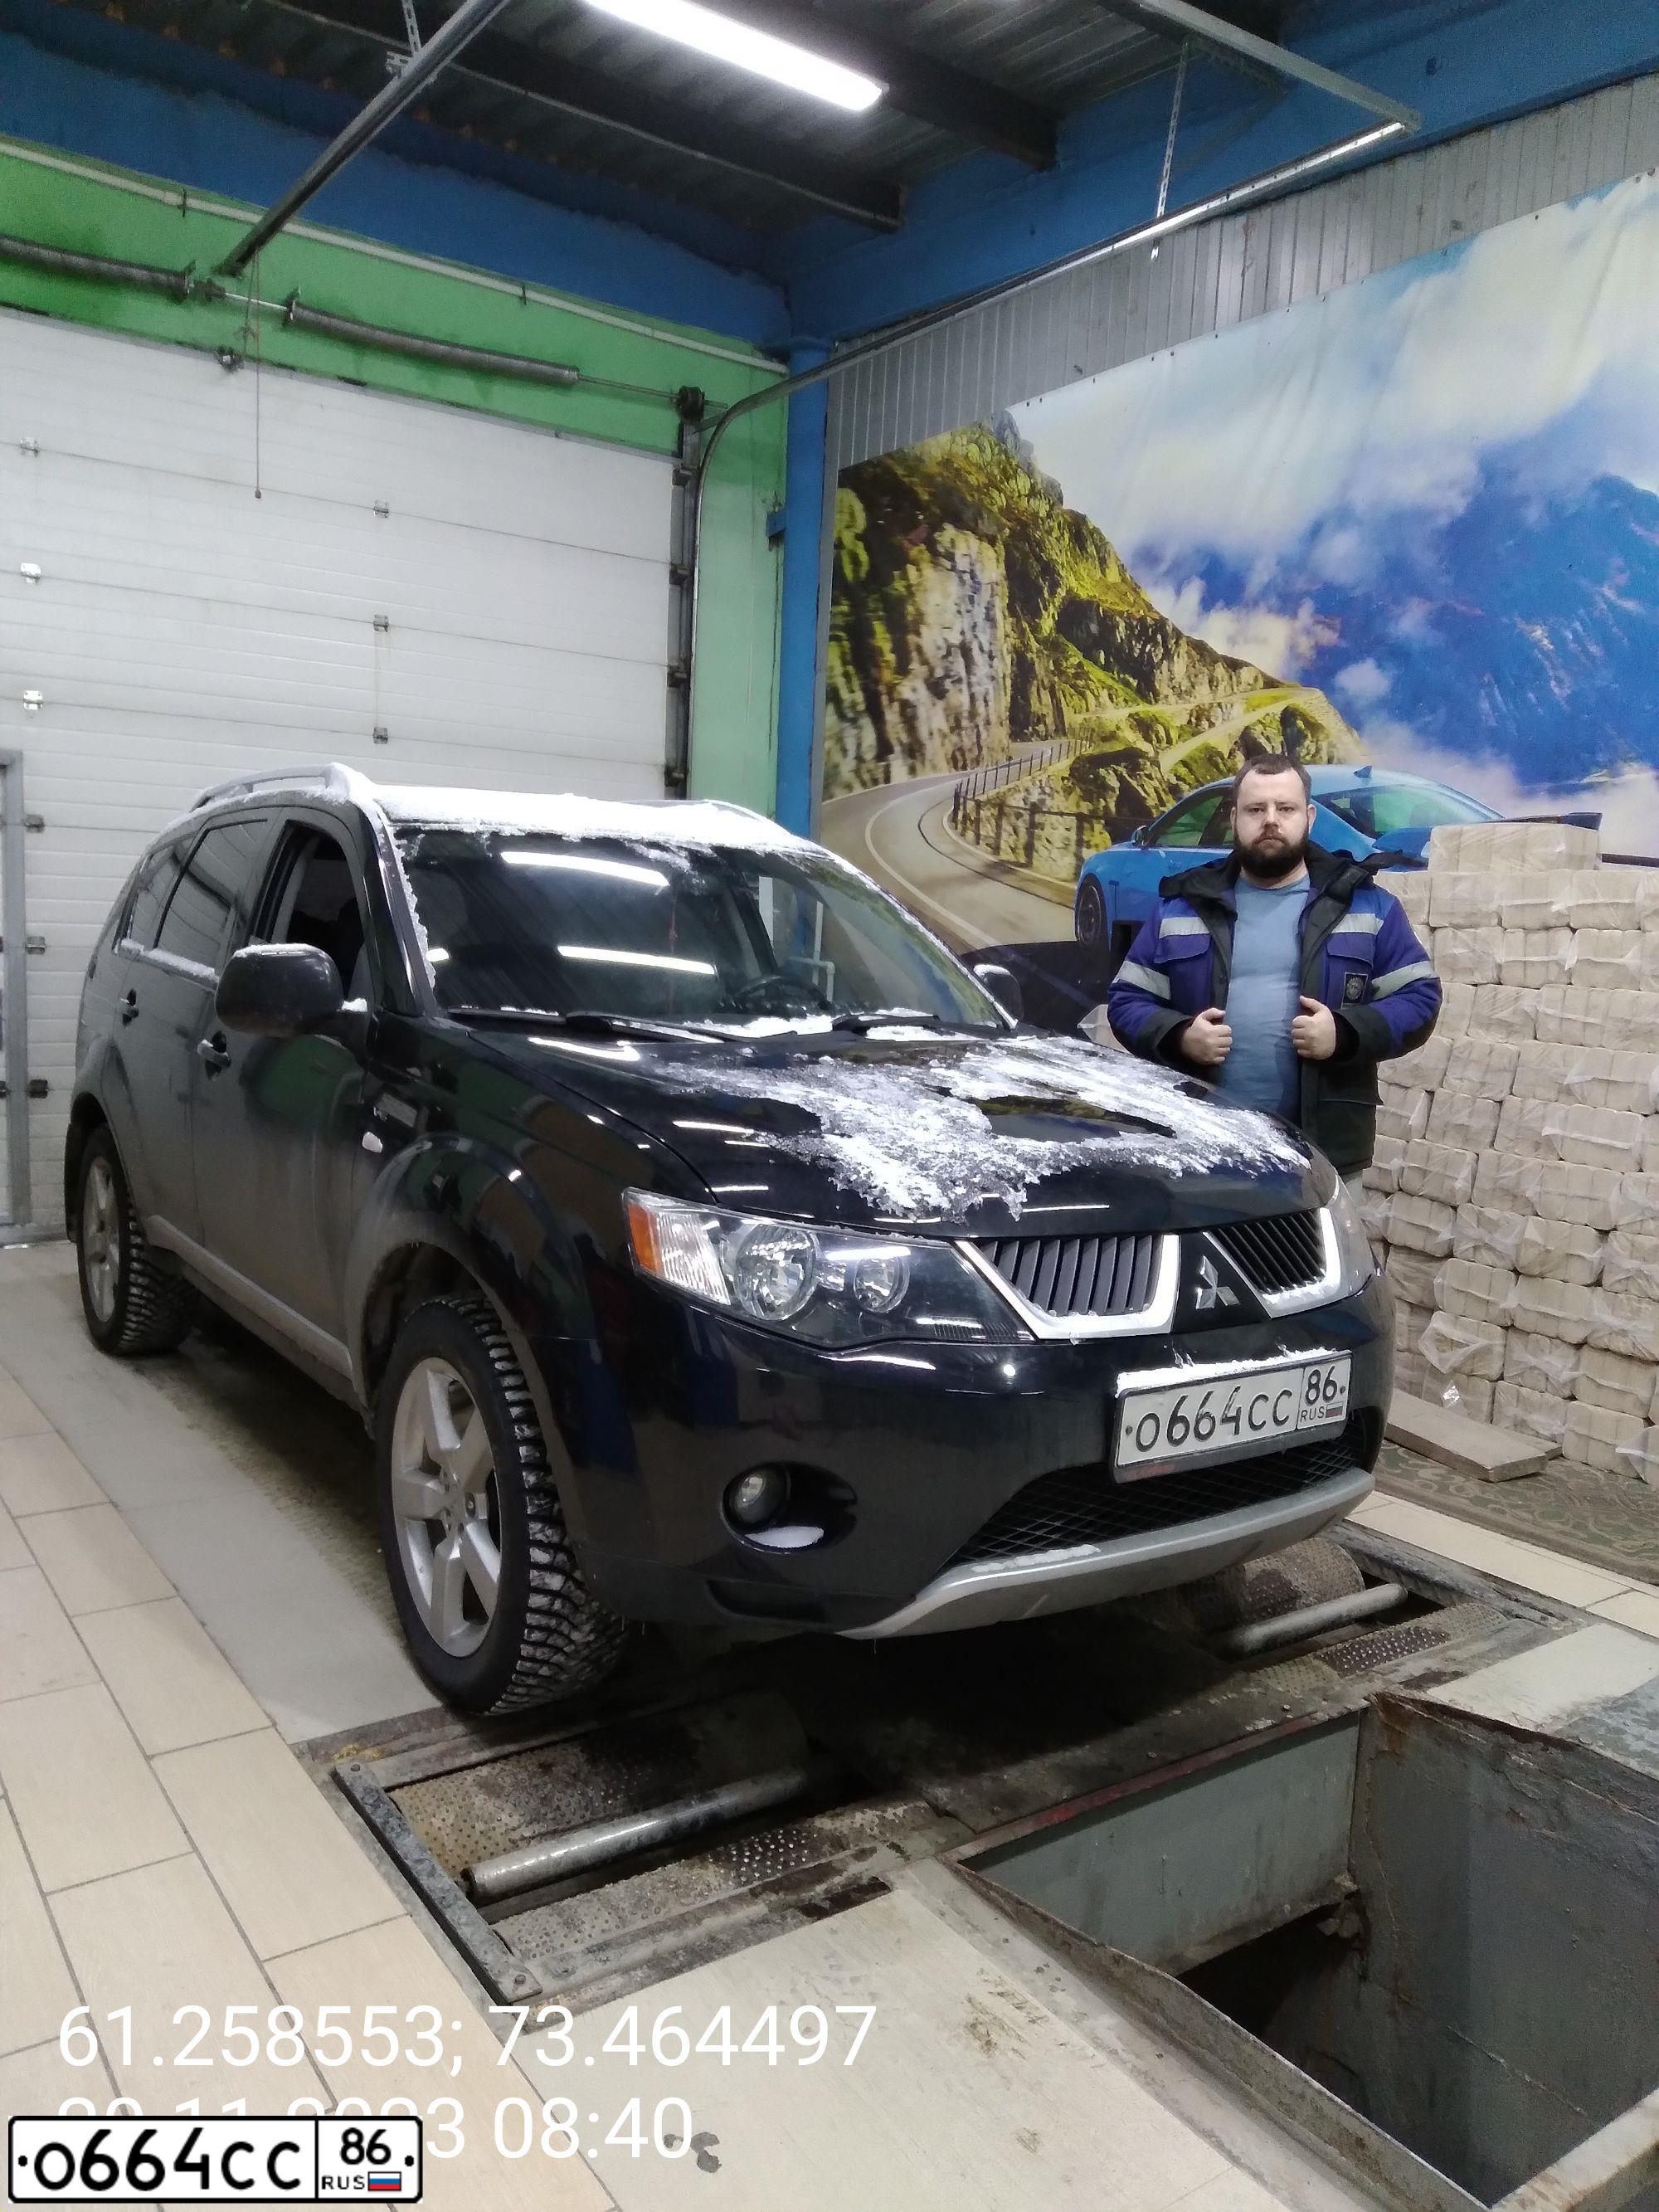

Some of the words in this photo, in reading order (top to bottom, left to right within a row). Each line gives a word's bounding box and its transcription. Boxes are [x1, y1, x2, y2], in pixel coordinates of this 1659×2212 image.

[1136, 1386, 1293, 1453] O664CC
[1305, 1366, 1338, 1406] 86
[1300, 1406, 1325, 1420] RUS
